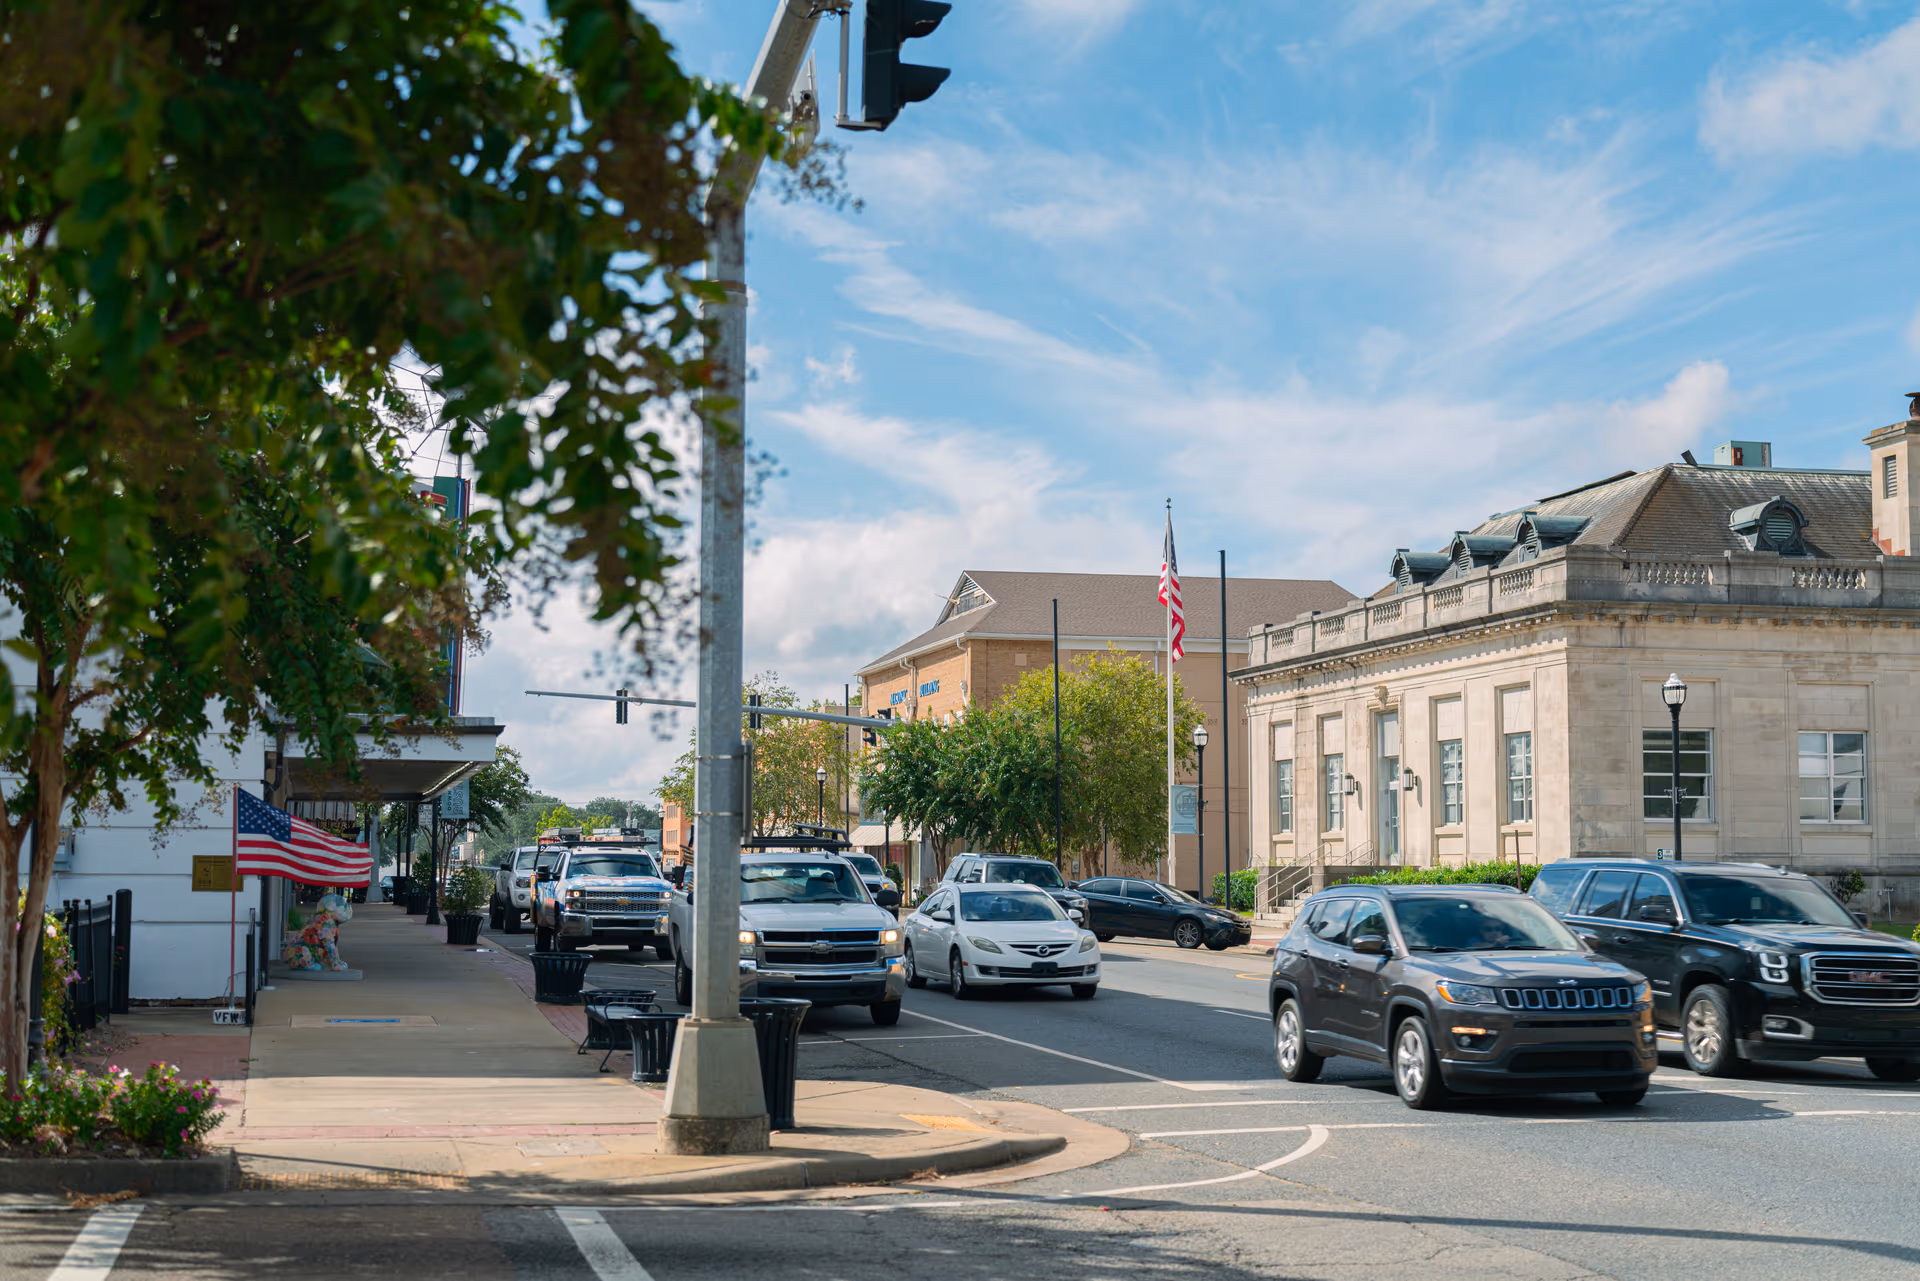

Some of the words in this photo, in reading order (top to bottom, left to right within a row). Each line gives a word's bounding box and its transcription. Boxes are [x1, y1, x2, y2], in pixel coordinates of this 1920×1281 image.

[919, 680, 939, 697] BUILDING
[1849, 971, 1892, 982] GMC
[215, 1011, 239, 1023] VFW
